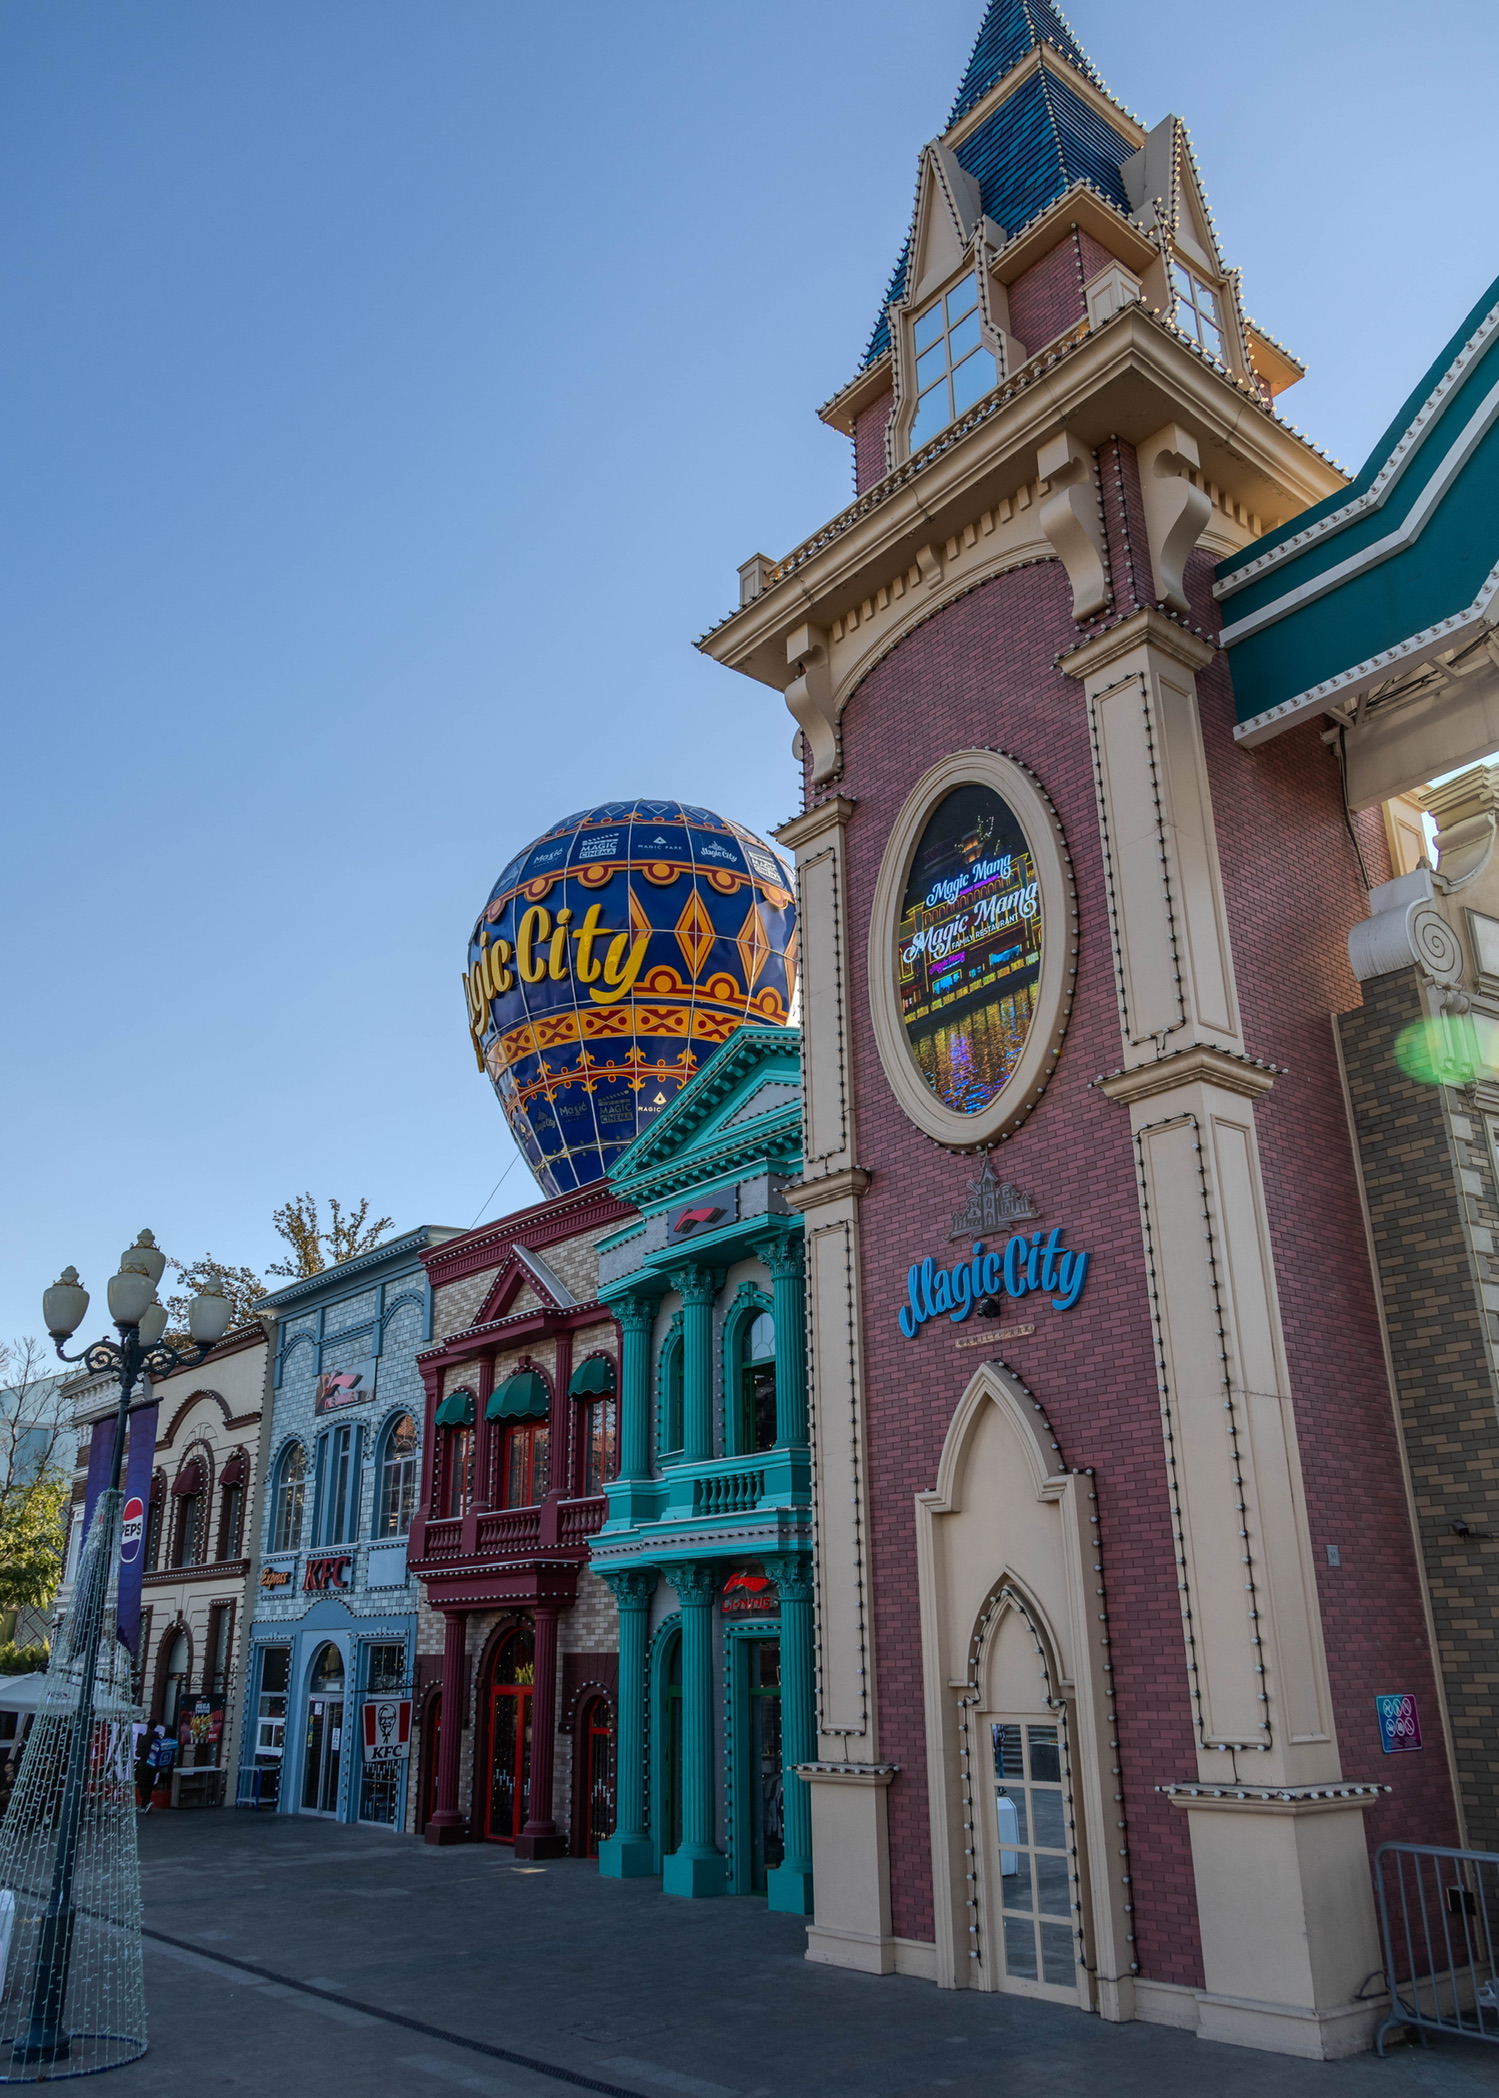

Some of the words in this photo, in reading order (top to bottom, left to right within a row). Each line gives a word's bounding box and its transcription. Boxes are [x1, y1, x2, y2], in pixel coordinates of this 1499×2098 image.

[580, 842, 618, 852] MAGIC
[580, 849, 615, 859] CINEMA
[925, 873, 969, 907] Magic
[972, 854, 1011, 884] Mama
[903, 914, 969, 963] Magic
[974, 881, 1038, 926] Mama
[951, 934, 974, 950] FAMILY
[975, 913, 1019, 939] RESTAURANT
[516, 903, 649, 1004] City
[600, 1103, 632, 1115] MAGIC
[601, 1113, 632, 1123] CINEMA
[898, 1241, 1003, 1339] Magic
[1004, 1227, 1090, 1311] City
[260, 1567, 291, 1590] Express
[302, 1556, 352, 1591] KFC
[721, 1597, 771, 1613] LI-NING
[371, 1744, 403, 1760] KFC
